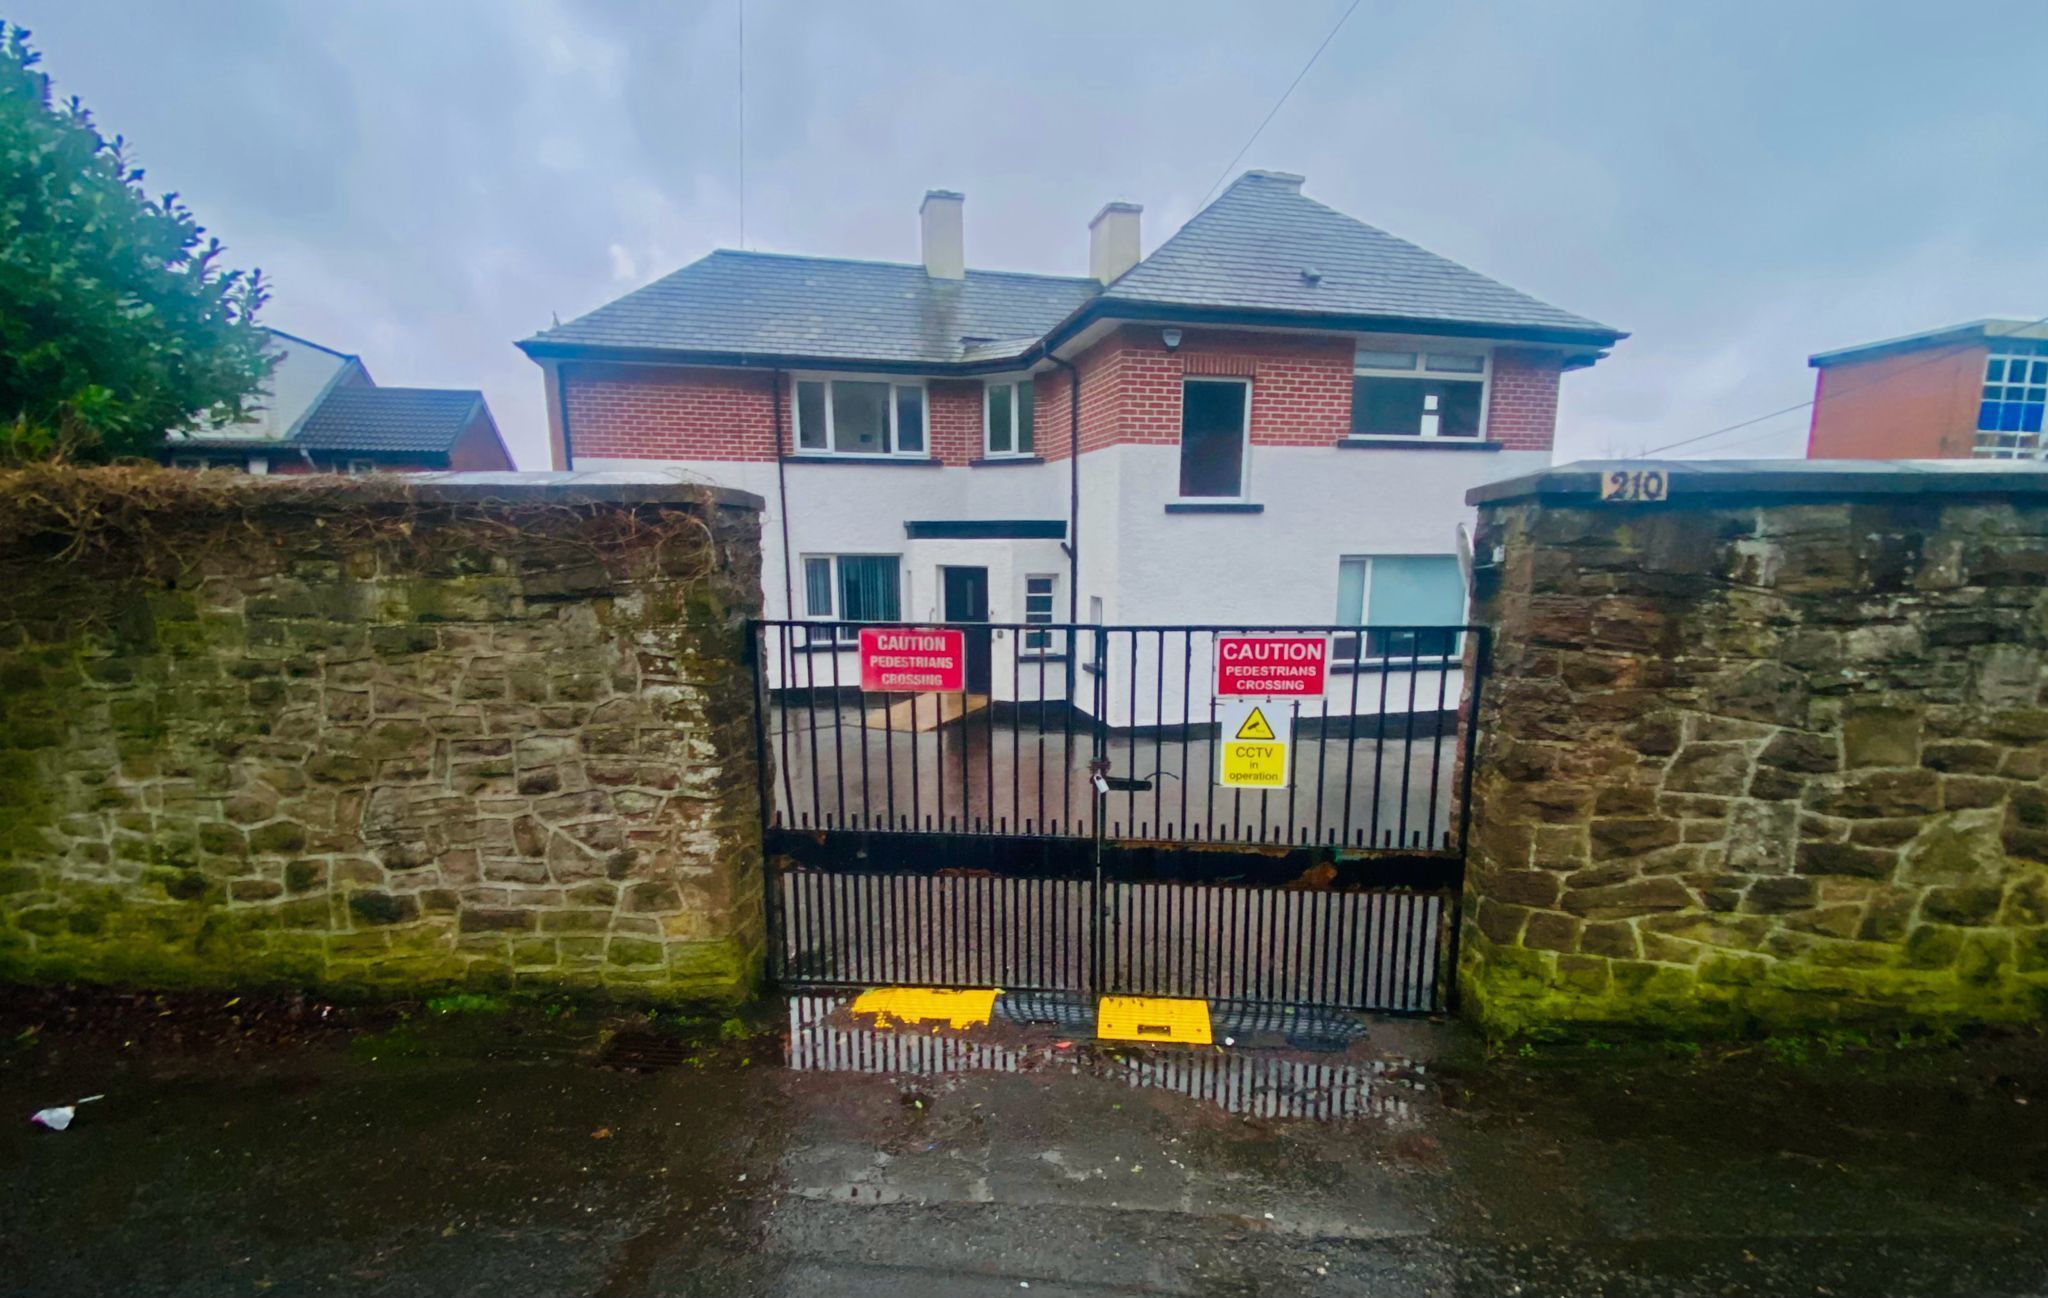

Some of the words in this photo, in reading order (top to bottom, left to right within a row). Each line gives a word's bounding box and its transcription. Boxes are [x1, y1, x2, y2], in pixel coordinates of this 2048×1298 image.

[1606, 470, 1663, 501] 210
[877, 635, 946, 652] CAUTION
[1223, 642, 1322, 661] CAUTION
[869, 655, 954, 669] PEDESTRIANS
[1225, 665, 1317, 677] PEDESTRIANS
[881, 673, 943, 686] CROSSING
[1236, 679, 1305, 691] CROSSING
[1235, 746, 1274, 758] CCTV
[1249, 760, 1259, 769] in
[1229, 771, 1279, 782] operation
